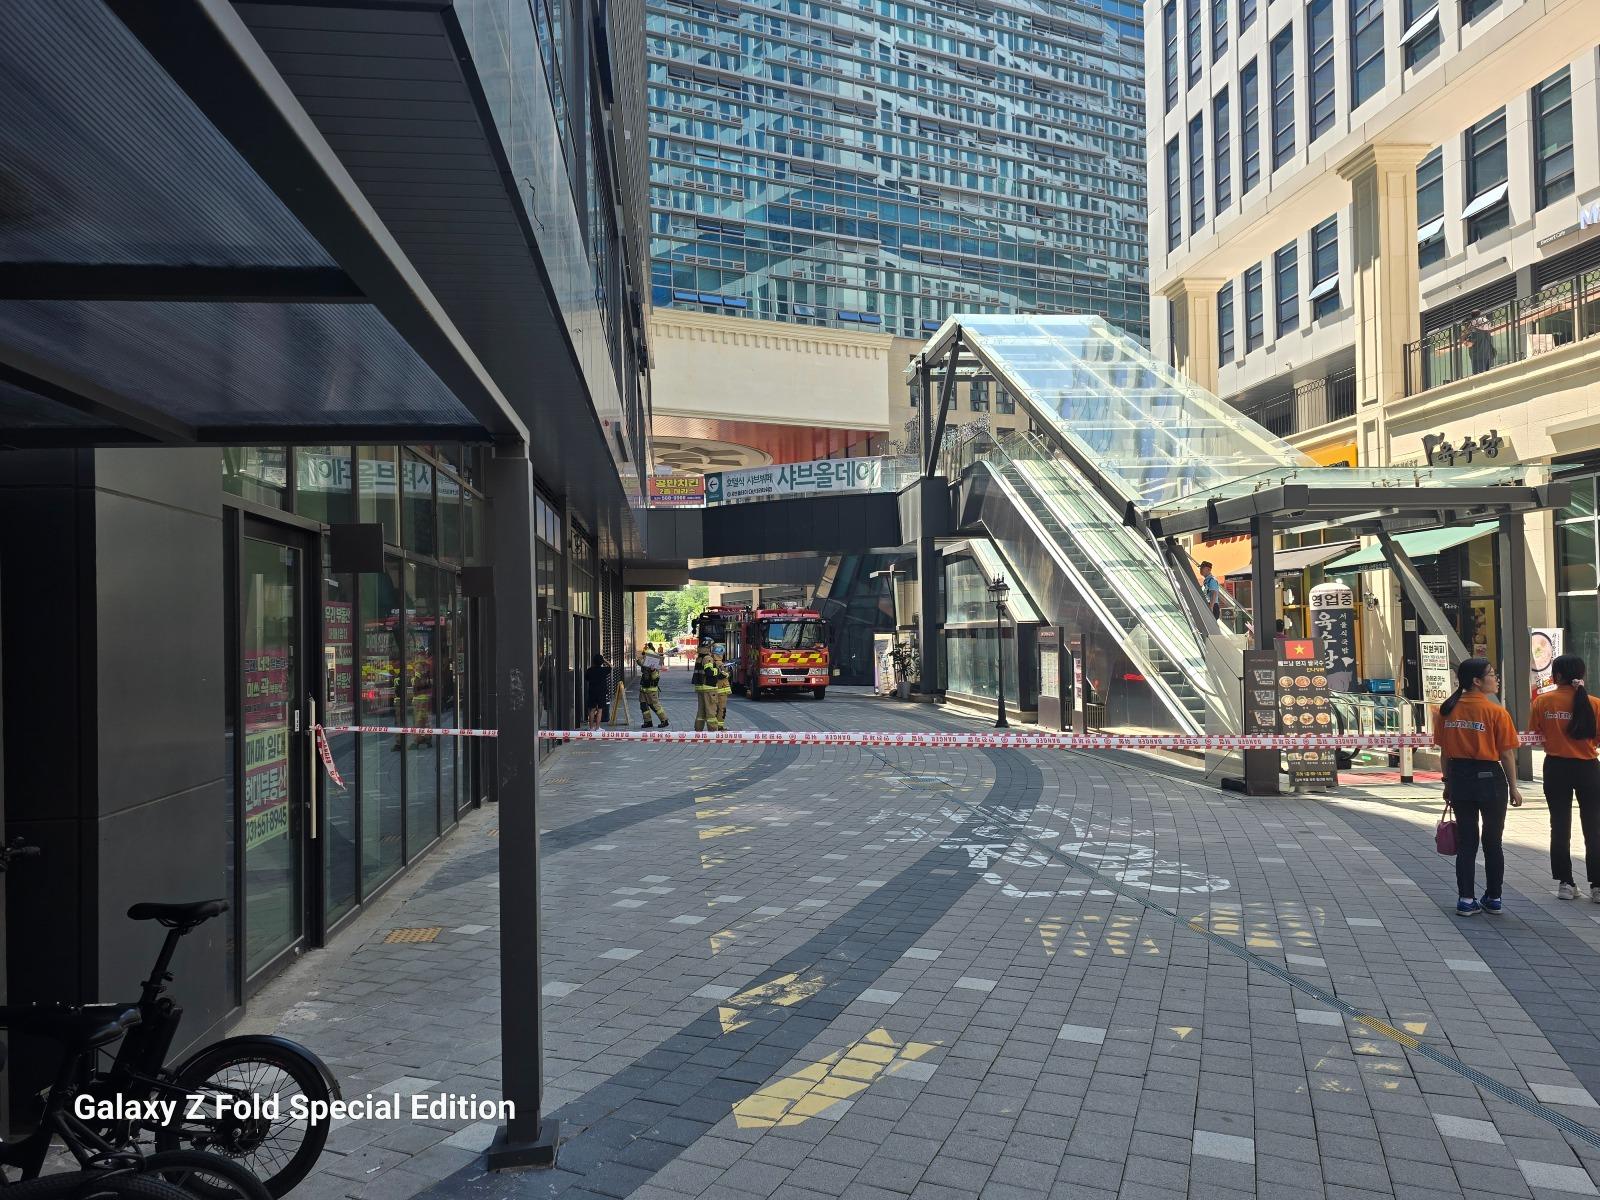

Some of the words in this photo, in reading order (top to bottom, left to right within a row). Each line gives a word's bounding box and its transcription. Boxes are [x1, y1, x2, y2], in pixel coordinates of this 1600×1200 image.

[777, 460, 877, 491] 샤브올데이
[1311, 592, 1352, 607] 영업중
[1423, 645, 1445, 654] 천원커피
